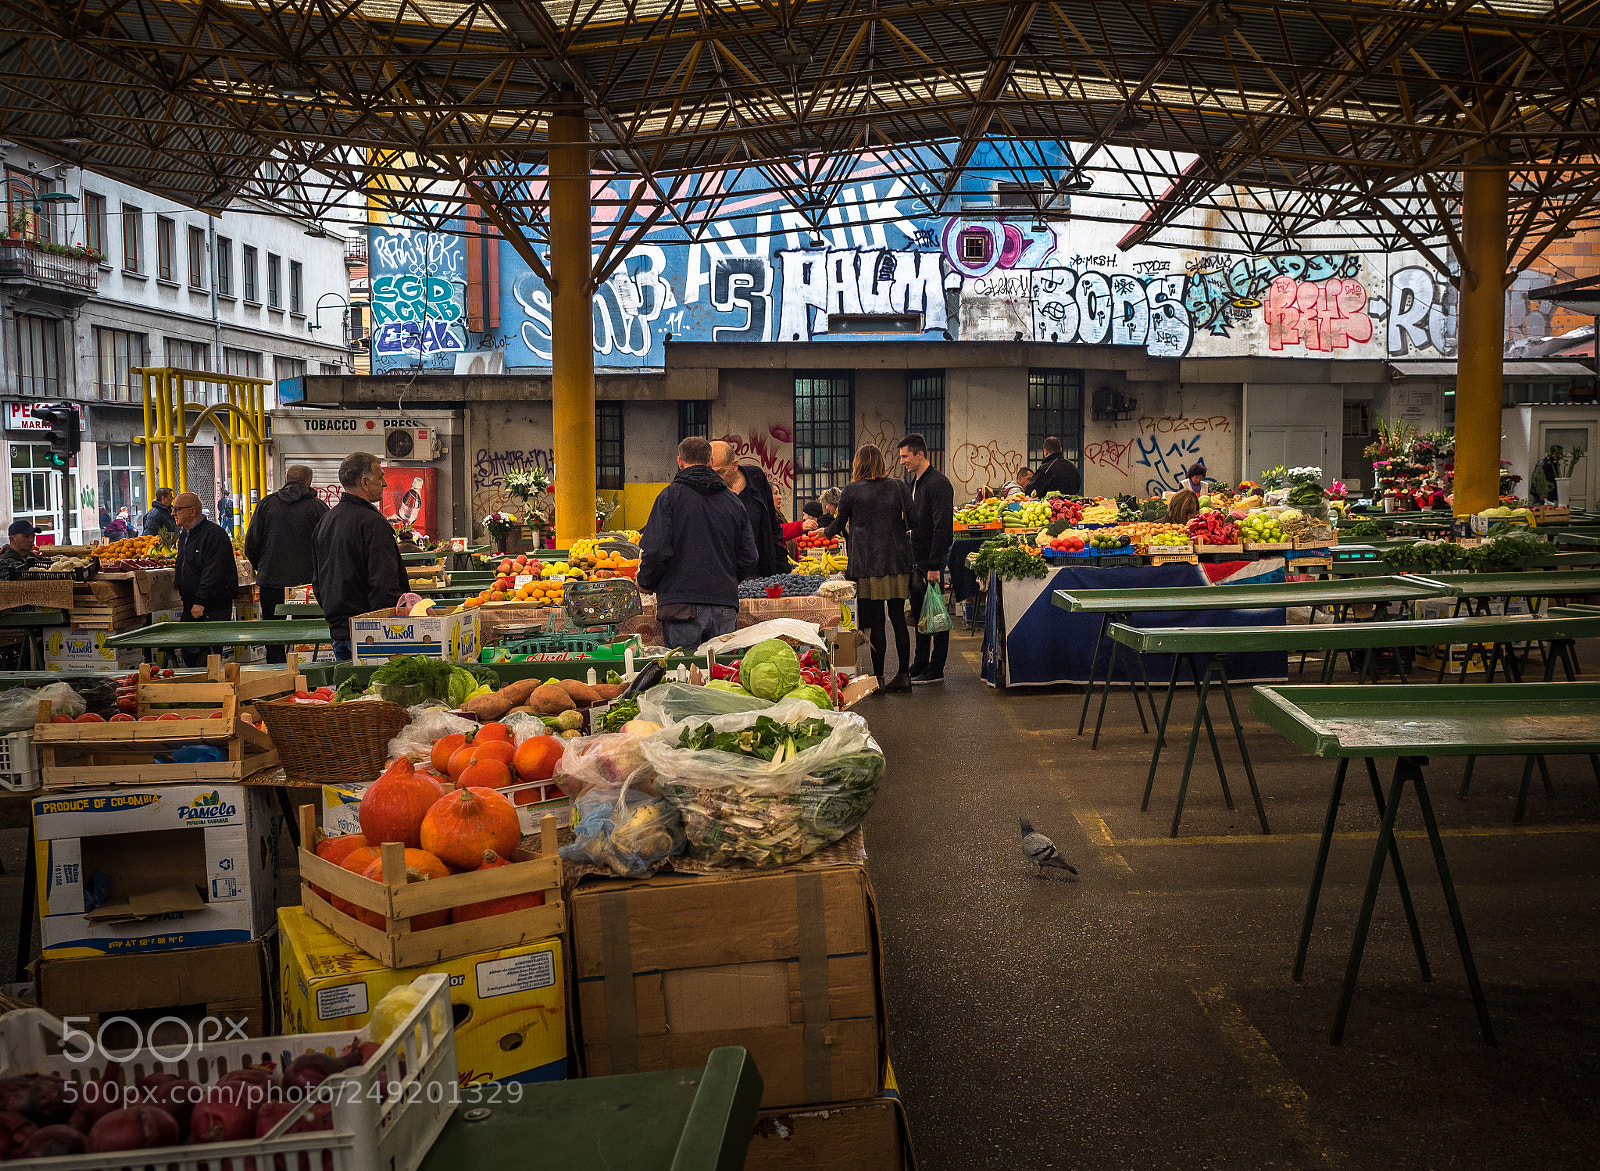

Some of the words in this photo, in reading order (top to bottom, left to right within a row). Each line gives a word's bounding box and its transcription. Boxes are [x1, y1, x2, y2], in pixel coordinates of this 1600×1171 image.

[373, 275, 455, 303] SGD
[371, 299, 462, 326] ACAB
[304, 419, 357, 431] TOBACCO
[382, 624, 415, 640] BONITA
[42, 799, 90, 814] PRODUCE
[94, 798, 106, 809] OF
[110, 793, 161, 807] COLOMBIA
[108, 941, 123, 949] KEEP
[126, 939, 136, 948] AT
[157, 937, 166, 945] OR
